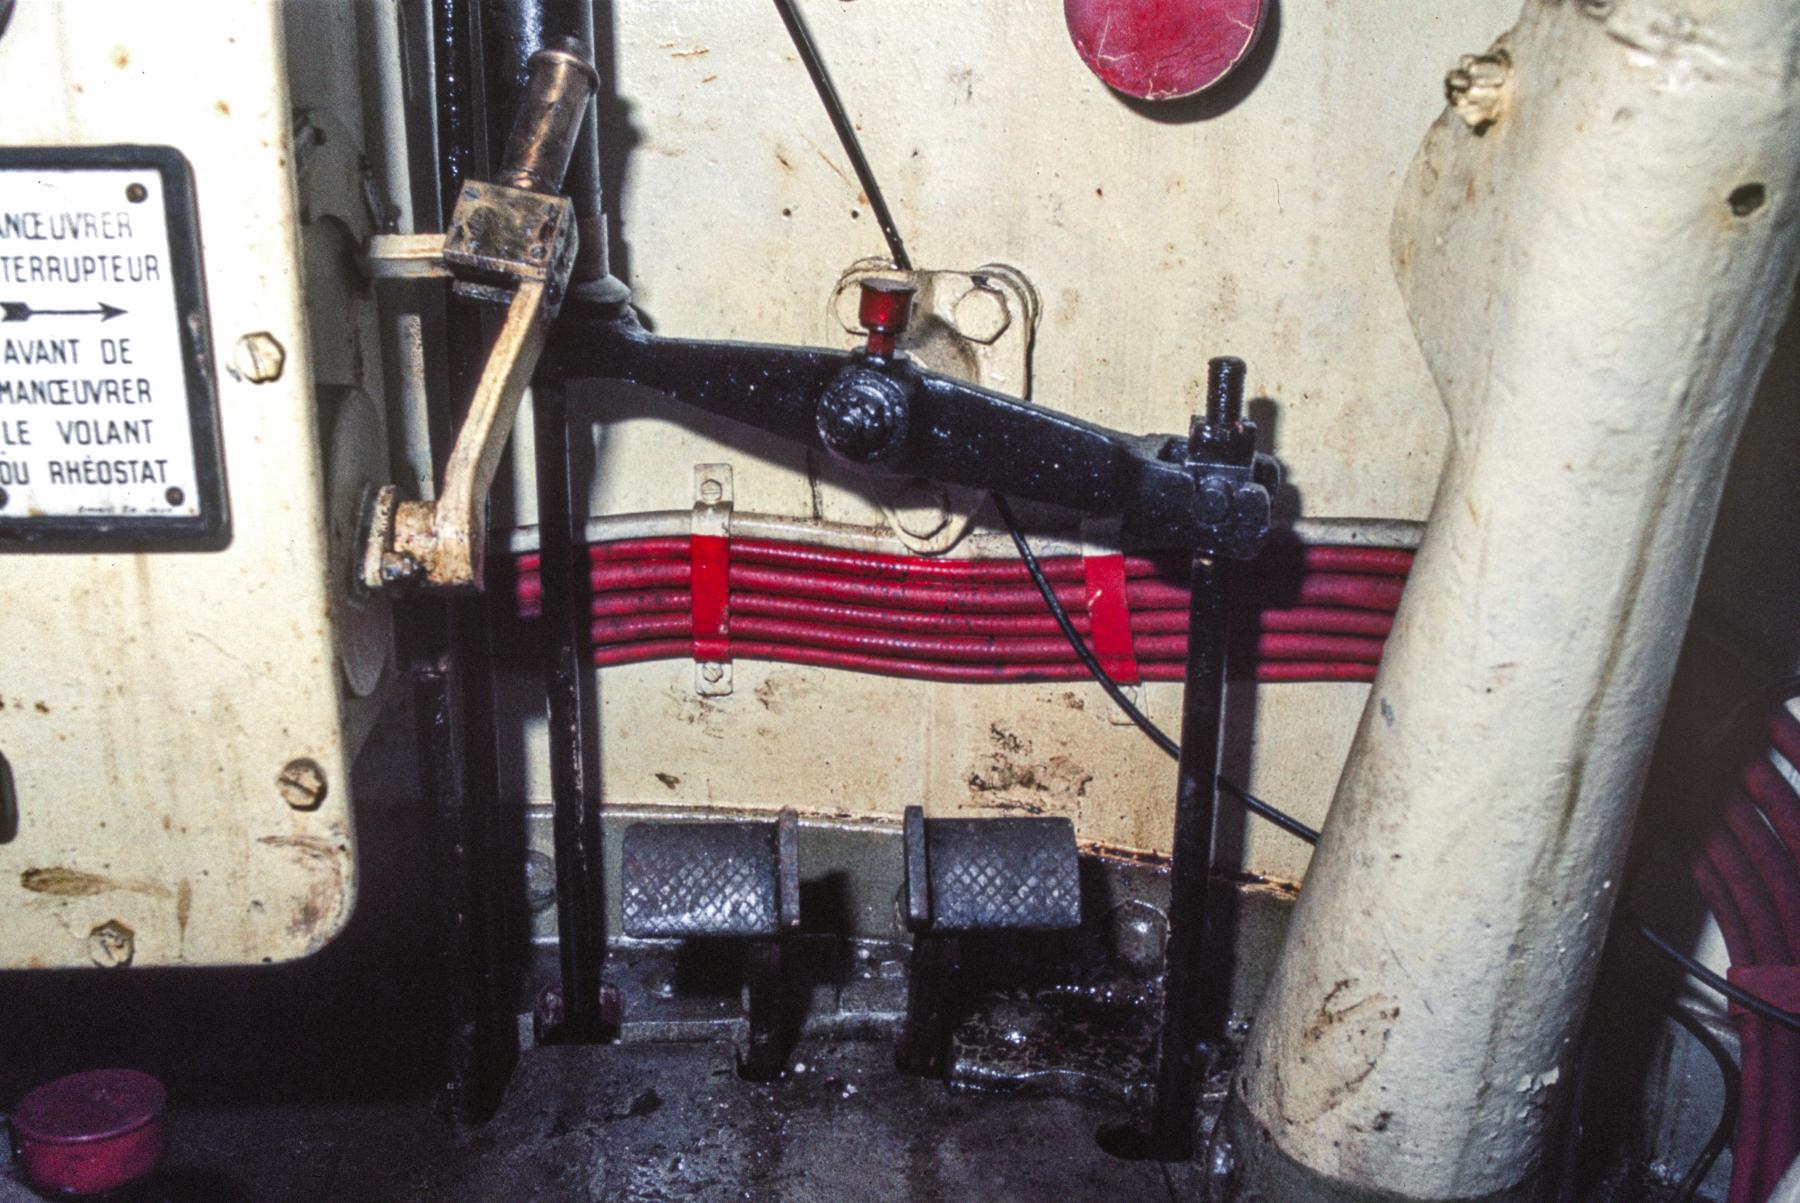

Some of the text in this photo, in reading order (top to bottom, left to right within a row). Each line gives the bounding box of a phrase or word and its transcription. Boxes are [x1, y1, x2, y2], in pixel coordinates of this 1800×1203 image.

[0, 212, 132, 240] NŒUVRER
[4, 339, 133, 365] AVANT DE
[0, 379, 152, 405] MANŒUVRER
[2, 420, 153, 445] LE VOLANT
